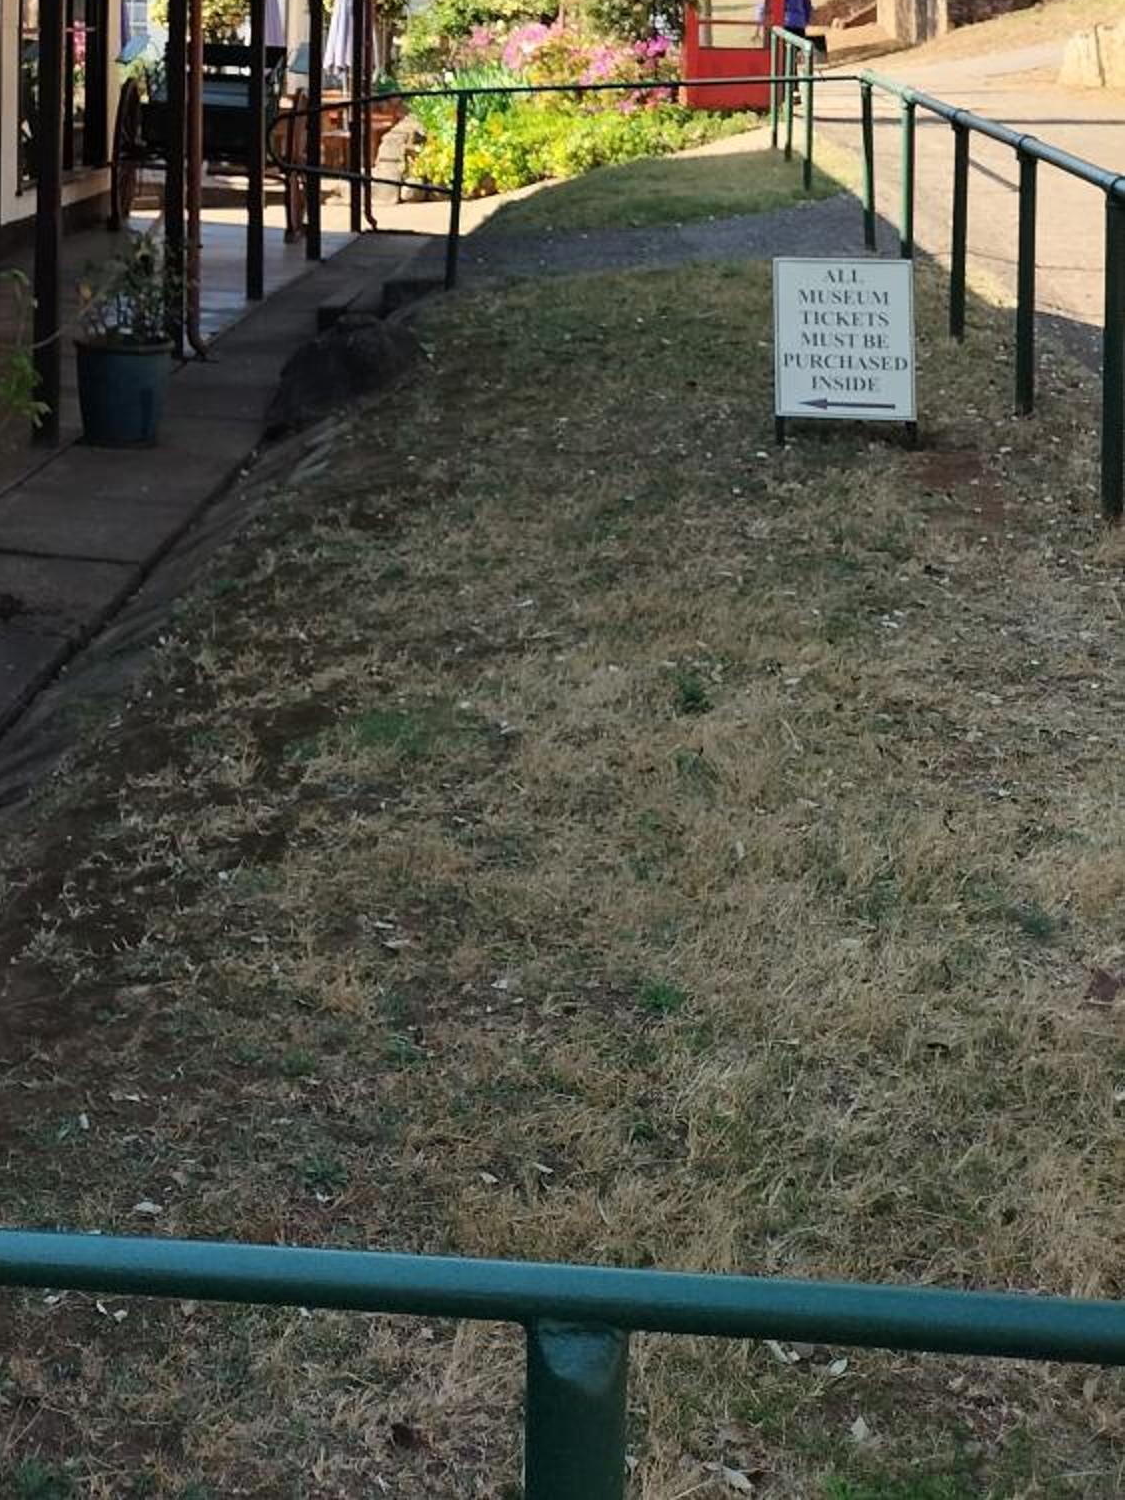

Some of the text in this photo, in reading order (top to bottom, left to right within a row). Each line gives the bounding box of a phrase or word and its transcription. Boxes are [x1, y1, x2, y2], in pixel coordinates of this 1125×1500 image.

[826, 269, 864, 284] ALL
[799, 289, 889, 306] MUSEUM
[802, 311, 890, 327] TICKETS
[801, 332, 890, 349] MUST BE
[783, 353, 909, 371] PURCHASED
[811, 376, 879, 392] INSIDE
